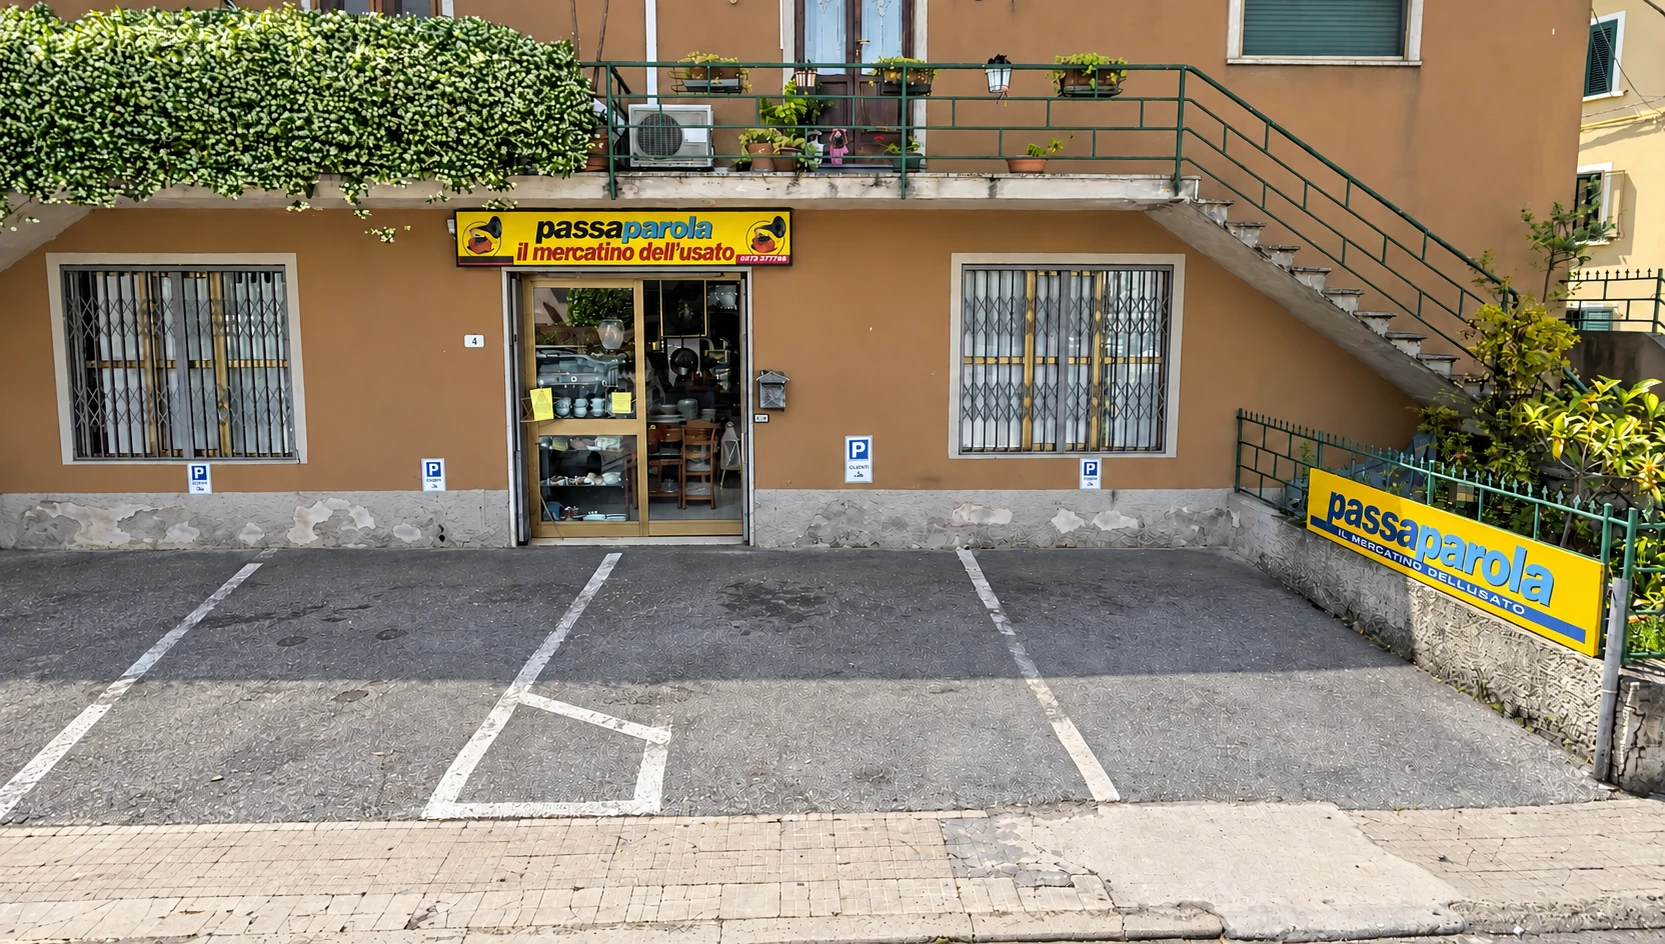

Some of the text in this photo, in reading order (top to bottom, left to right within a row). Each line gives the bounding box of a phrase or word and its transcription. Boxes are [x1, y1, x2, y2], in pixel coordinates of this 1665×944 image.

[535, 216, 713, 245] passaparola
[516, 242, 735, 261] il mercatino dell'usato
[471, 337, 478, 345] 4
[851, 441, 866, 459] P
[193, 466, 205, 480] P
[428, 463, 440, 476] P
[1085, 462, 1096, 475] P
[1327, 491, 1555, 607] passaparola
[1337, 528, 1348, 540] IL
[1351, 534, 1423, 571] MERCATINO
